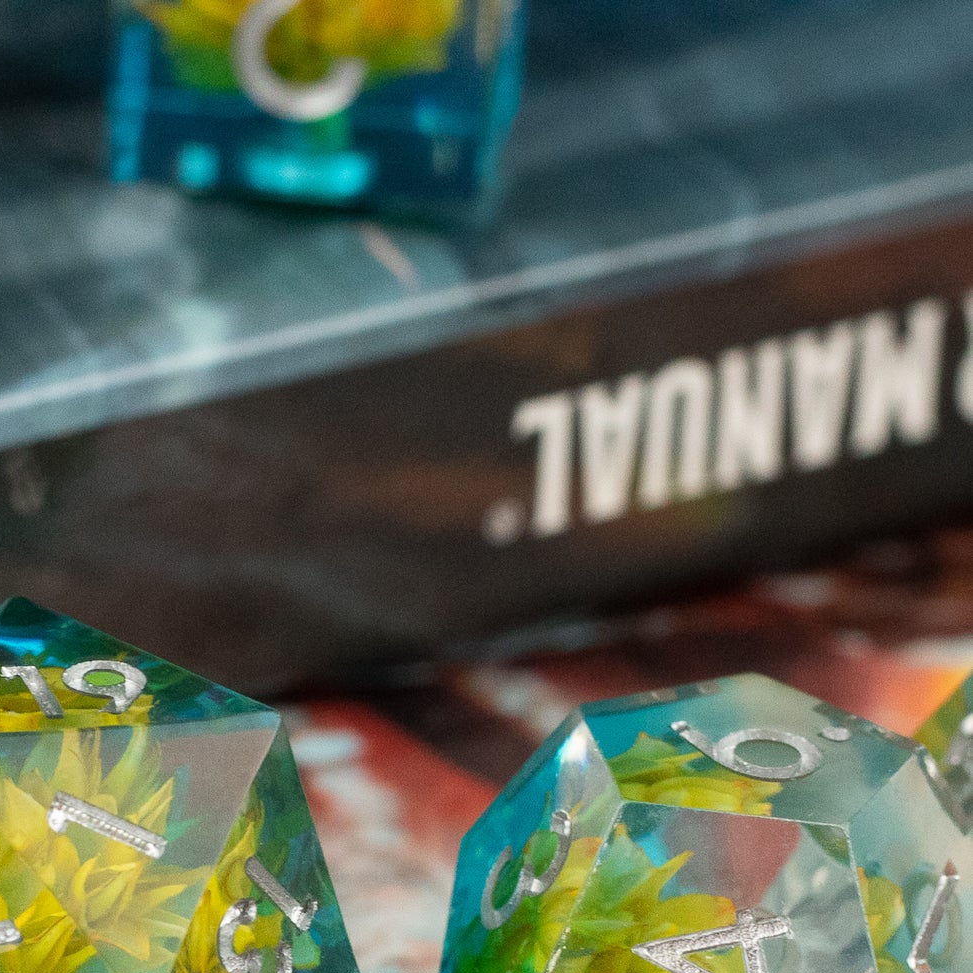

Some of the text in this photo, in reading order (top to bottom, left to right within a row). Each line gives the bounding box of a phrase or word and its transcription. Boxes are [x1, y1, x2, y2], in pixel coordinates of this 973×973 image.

[511, 297, 947, 537] MANUAL
[0, 660, 147, 718] 19
[46, 791, 169, 859] 1
